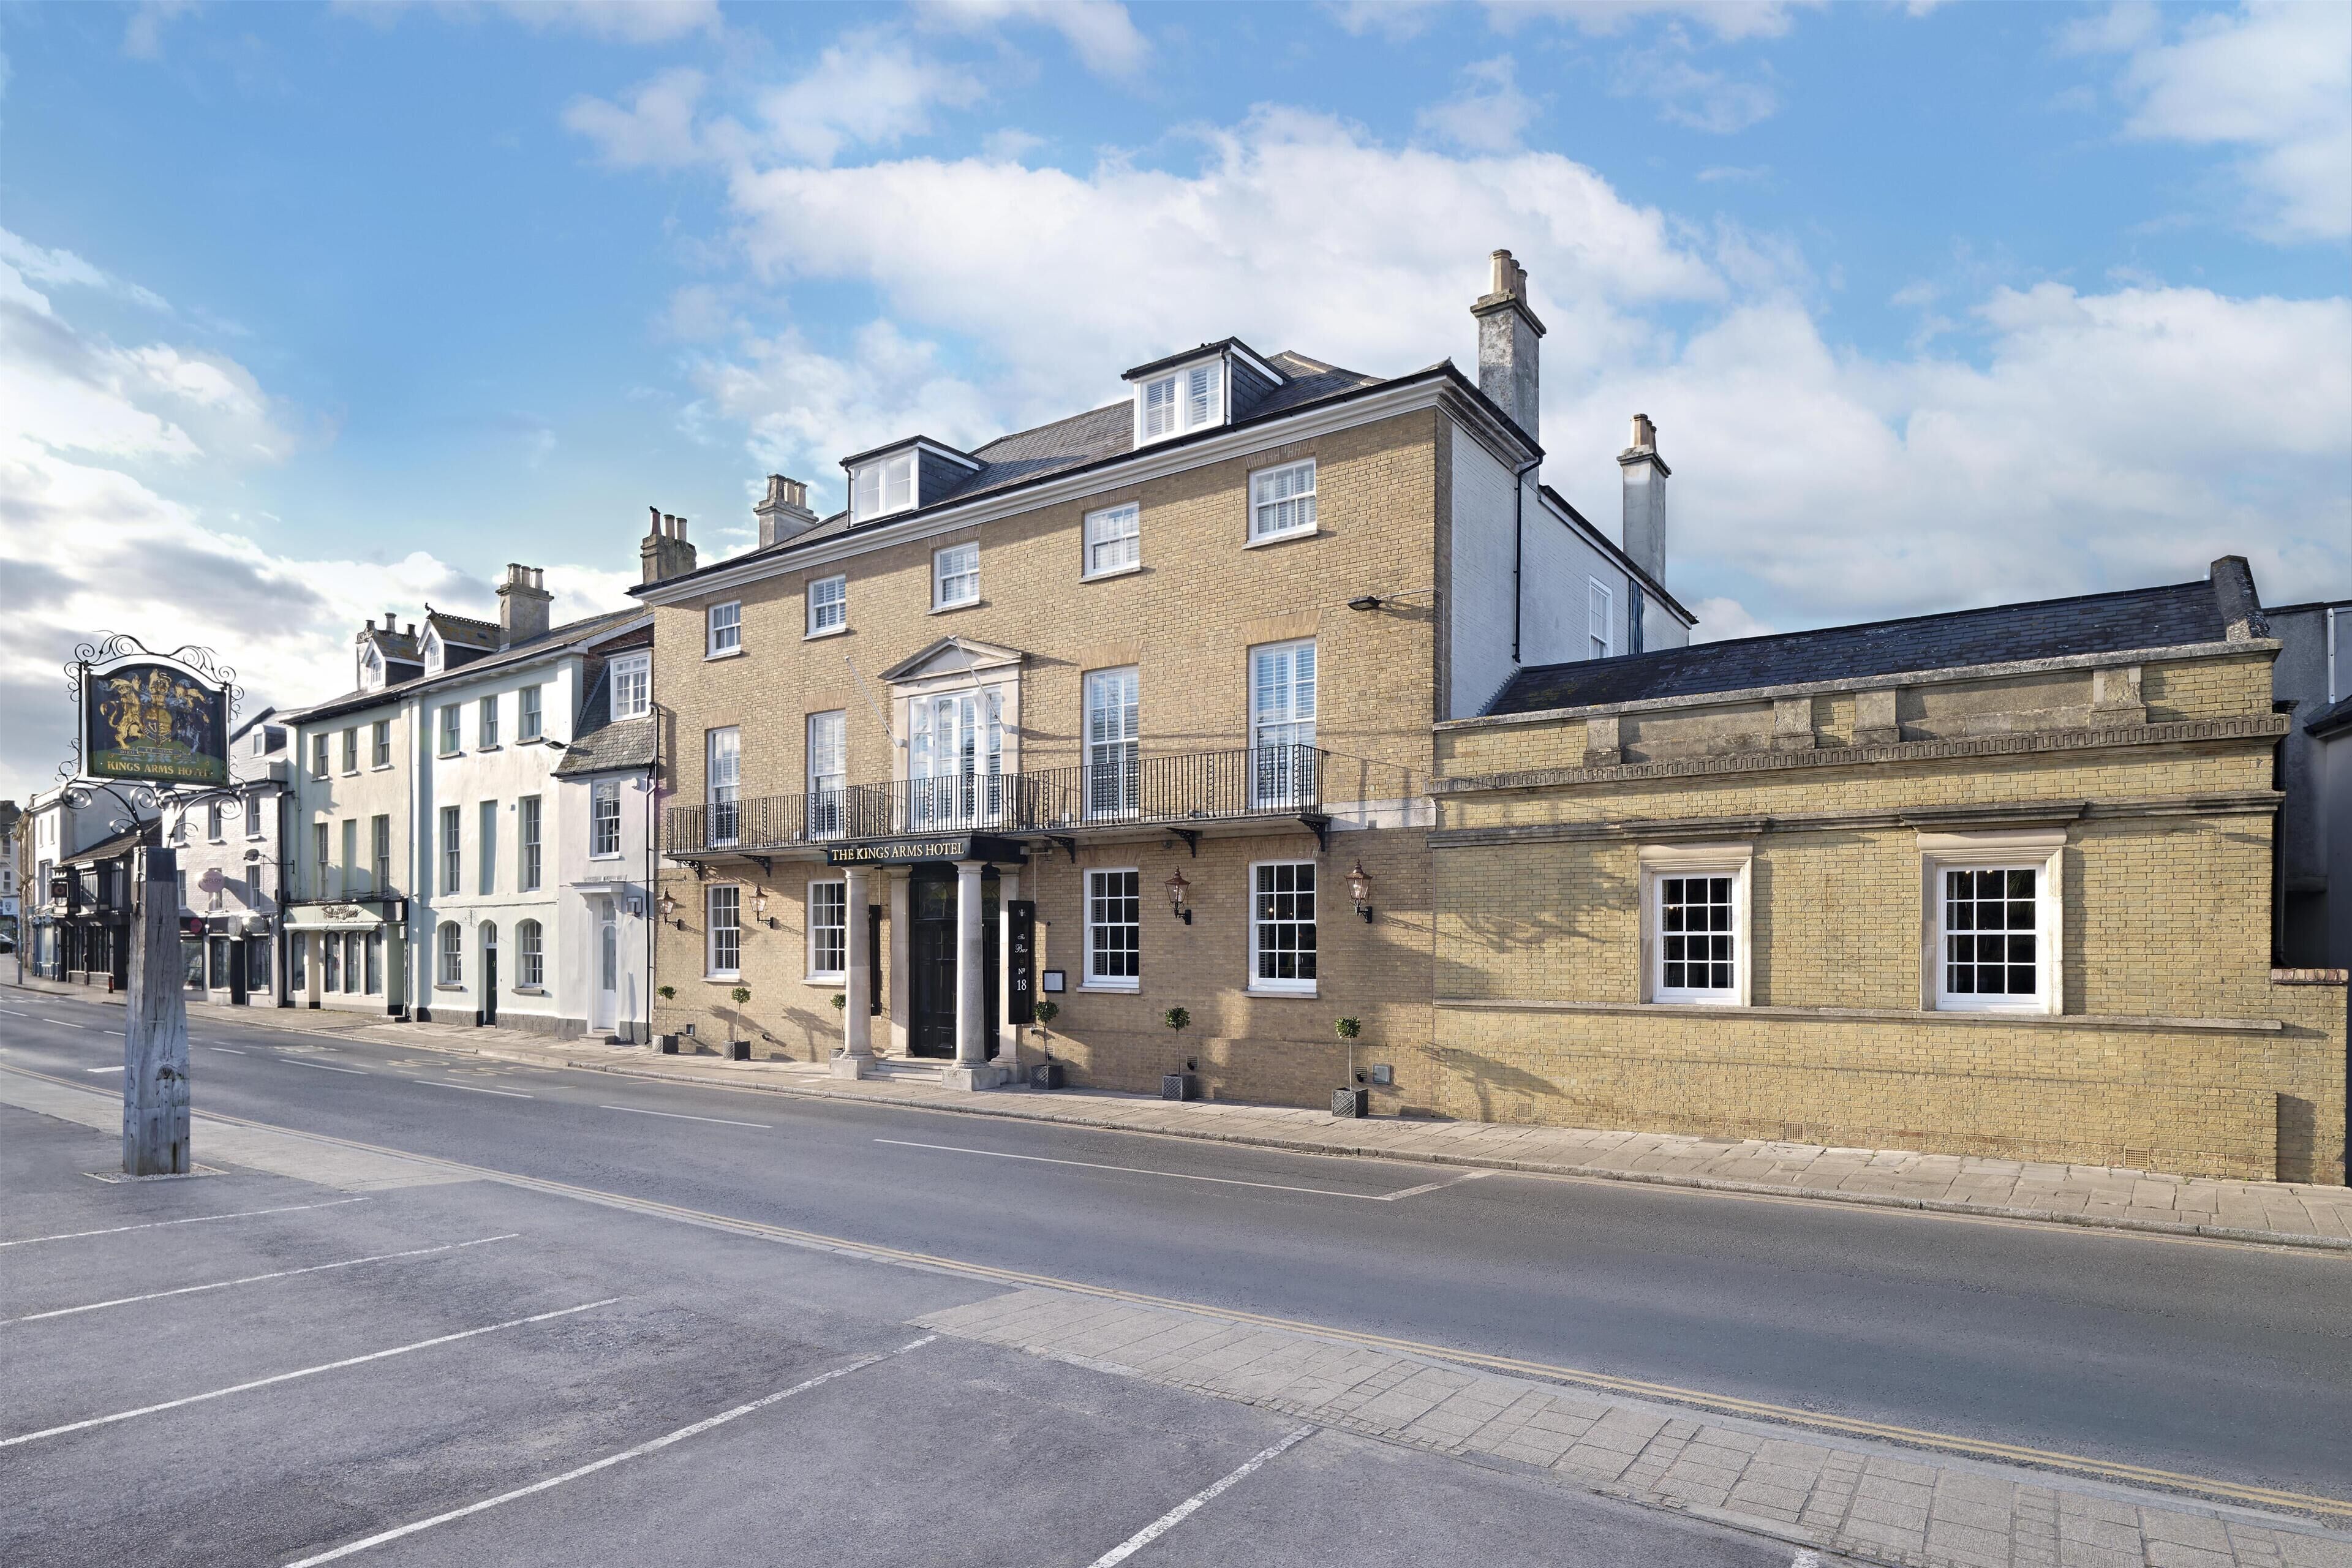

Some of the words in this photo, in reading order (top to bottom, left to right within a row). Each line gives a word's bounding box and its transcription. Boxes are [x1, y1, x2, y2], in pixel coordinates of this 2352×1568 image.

[107, 761, 140, 772] KINGS
[144, 764, 174, 774] ARMS
[832, 849, 854, 861] THE
[856, 846, 889, 859] KINGS
[891, 845, 923, 858] ARMS
[925, 842, 964, 856] HOTEL
[1015, 943, 1028, 953] Bar
[1017, 979, 1027, 990] 18
